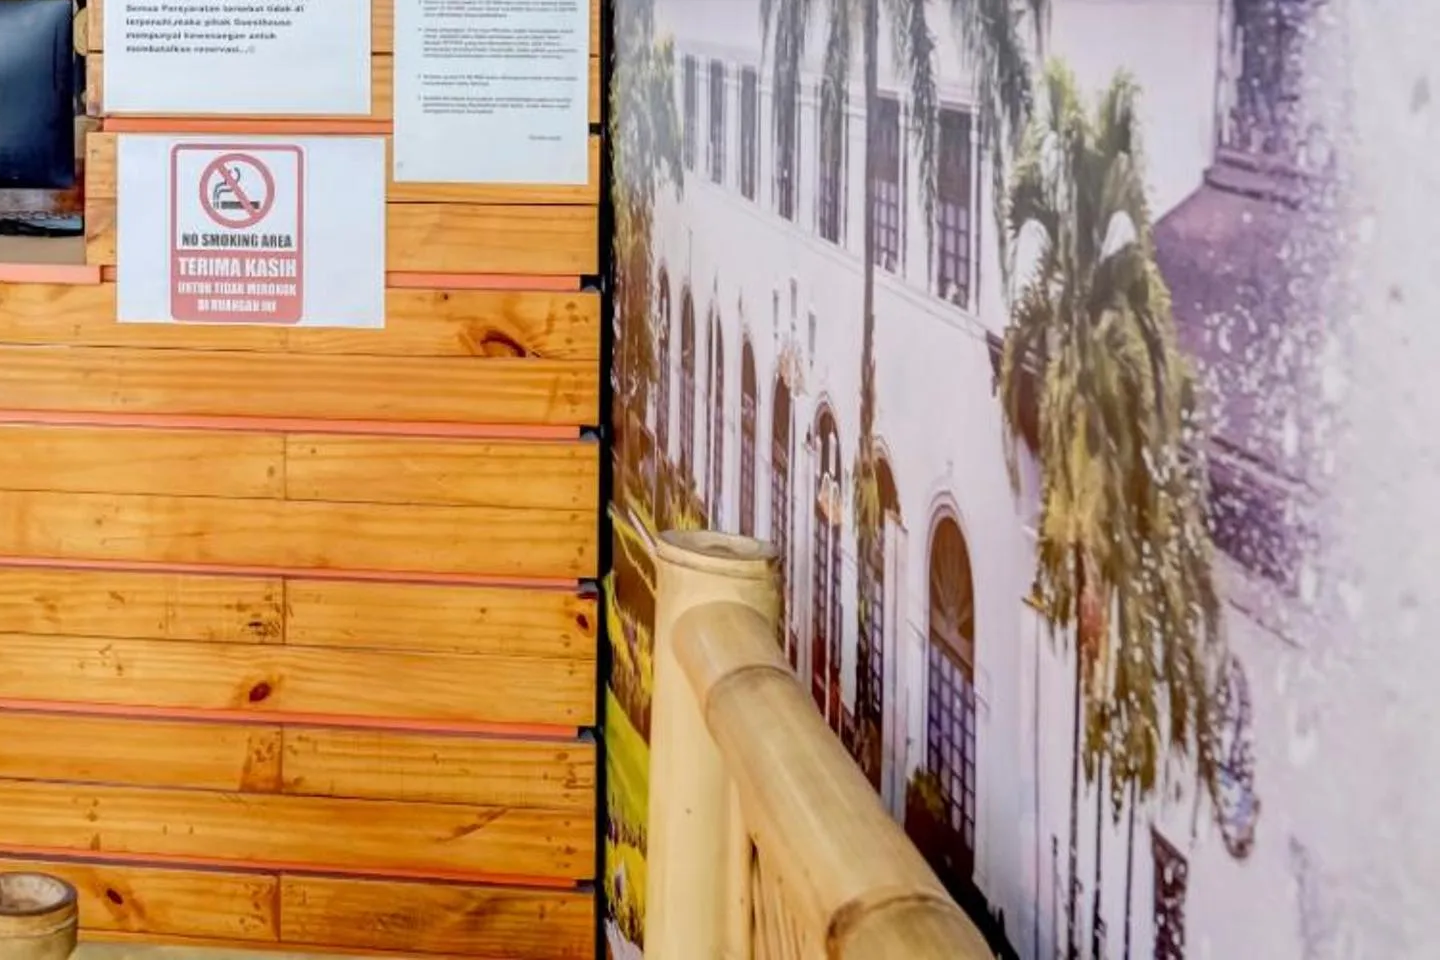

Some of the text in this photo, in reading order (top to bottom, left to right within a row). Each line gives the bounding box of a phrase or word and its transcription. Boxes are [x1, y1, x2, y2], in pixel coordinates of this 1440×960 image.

[182, 233, 293, 248] NO SMOKING AREA
[178, 257, 297, 277] TERIMA KASIH
